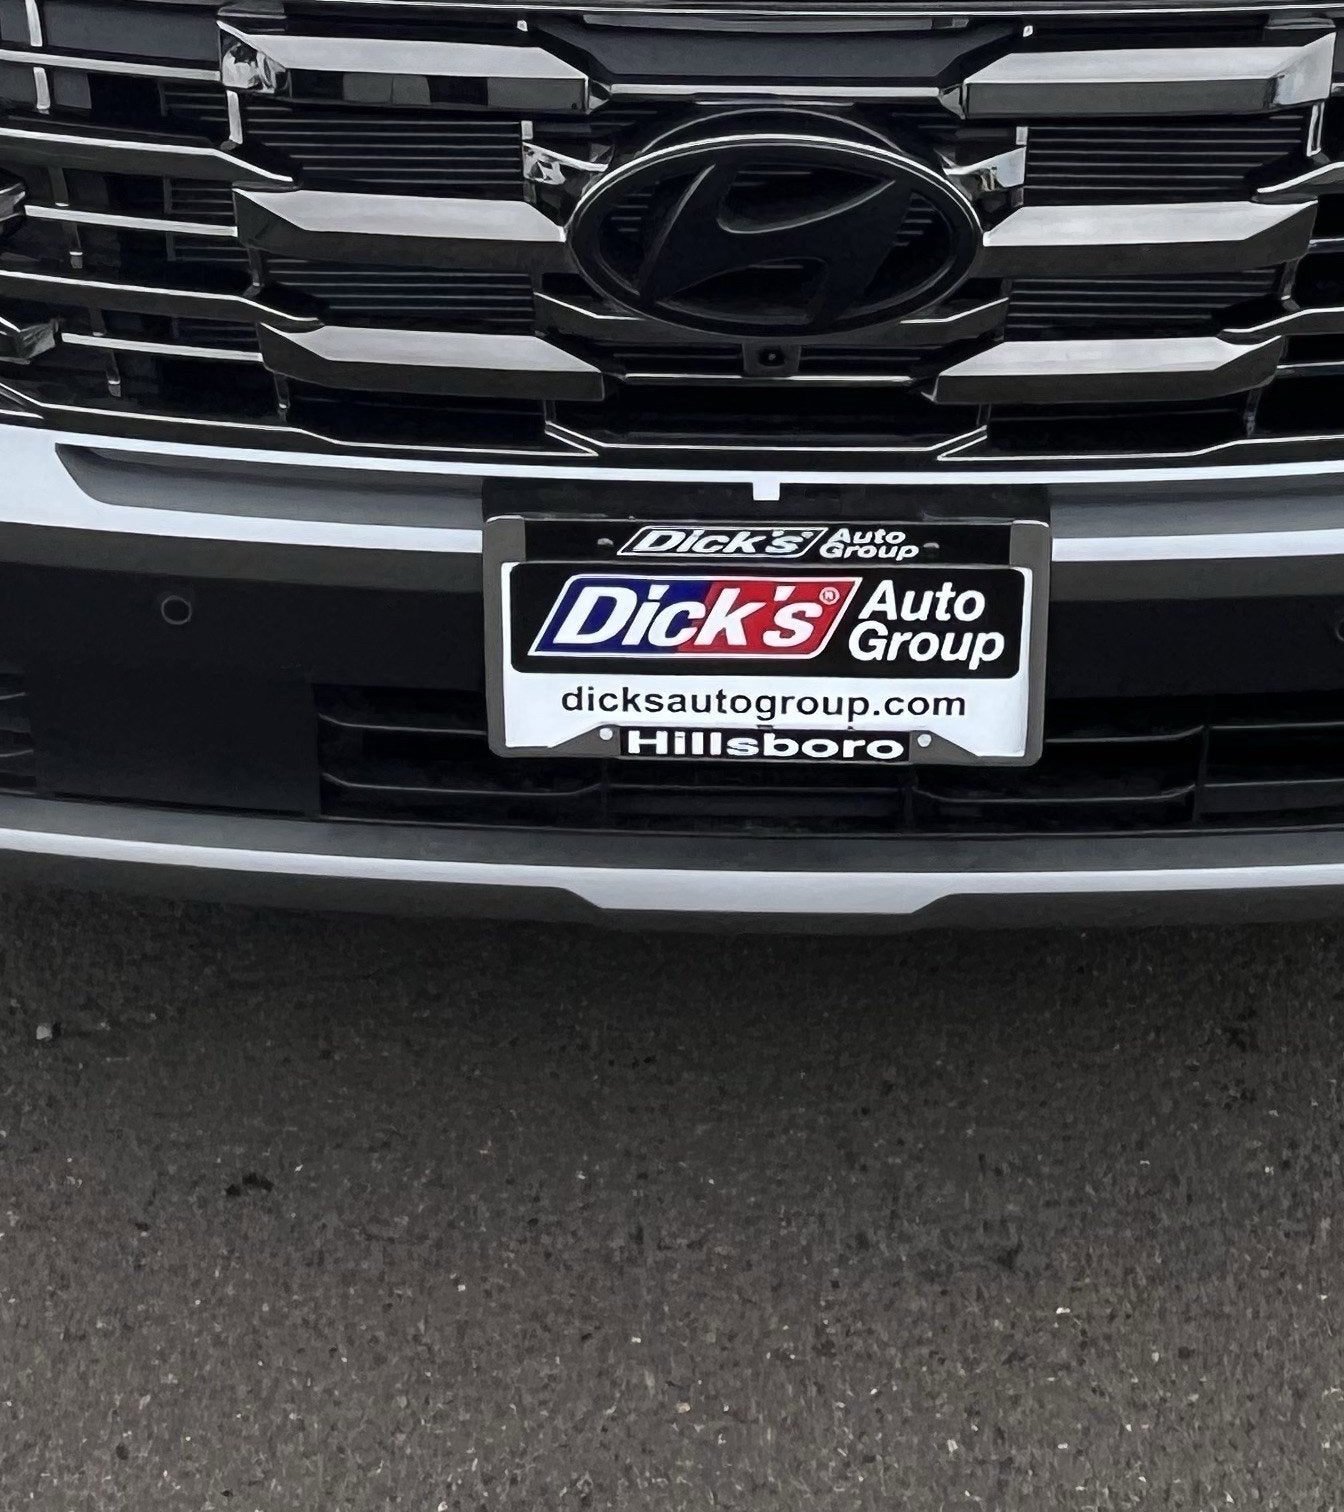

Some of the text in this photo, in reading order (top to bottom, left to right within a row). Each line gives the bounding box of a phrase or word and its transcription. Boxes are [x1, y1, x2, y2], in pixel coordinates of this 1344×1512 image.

[633, 529, 804, 554] Dick's
[819, 542, 919, 561] Group
[828, 528, 906, 545] Auto
[553, 584, 823, 648] Dick's
[859, 579, 986, 622] Auto
[848, 621, 1006, 670] Group
[561, 686, 966, 722] dicksautogroup.com
[627, 729, 905, 760] Hillsboro
